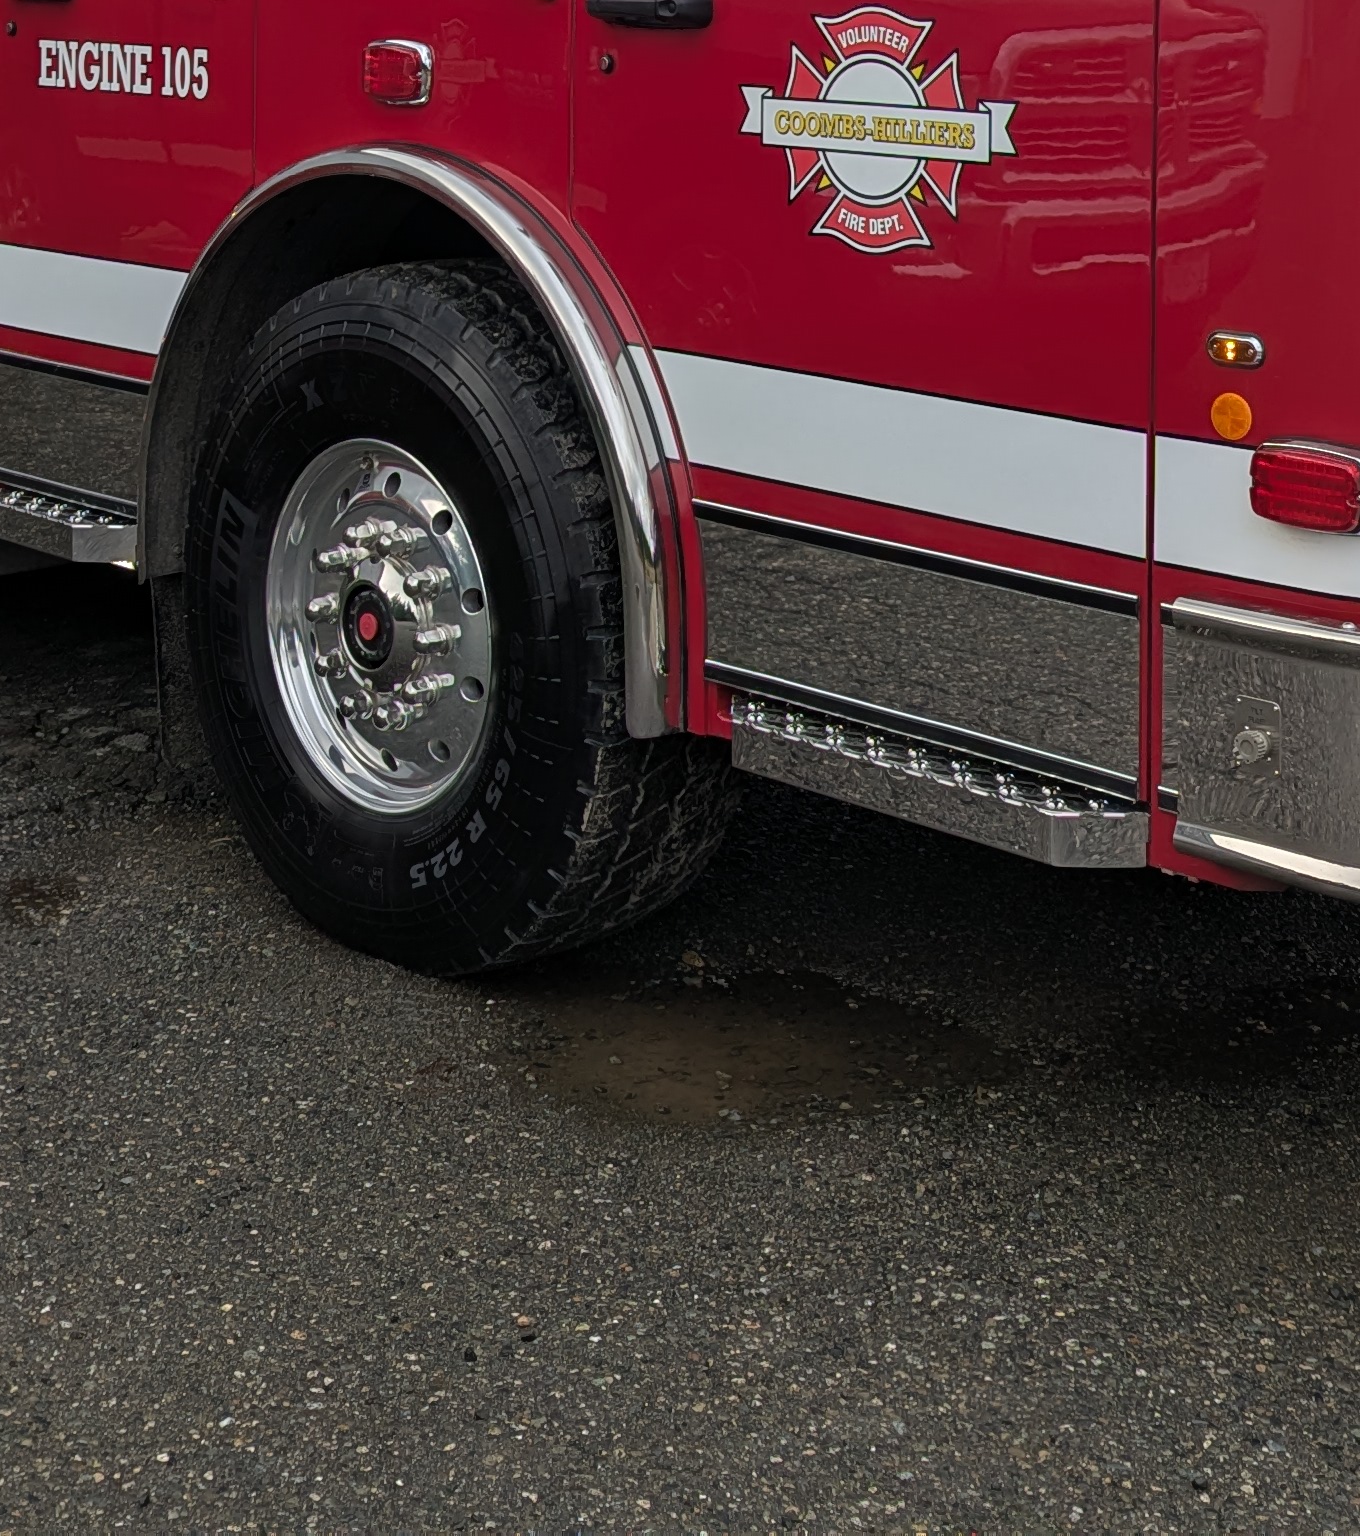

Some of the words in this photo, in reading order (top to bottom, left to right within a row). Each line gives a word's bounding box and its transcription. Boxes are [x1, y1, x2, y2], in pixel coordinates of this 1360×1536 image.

[837, 25, 909, 54] VOLUNTEER
[38, 39, 153, 95] ENGINE
[161, 46, 209, 100] 105
[774, 109, 976, 150] COOMBS-HILLIERS
[837, 207, 867, 234] FIRE
[869, 213, 904, 235] DEPT.
[217, 496, 286, 792] MICHELIN
[408, 836, 464, 890] 22.5
